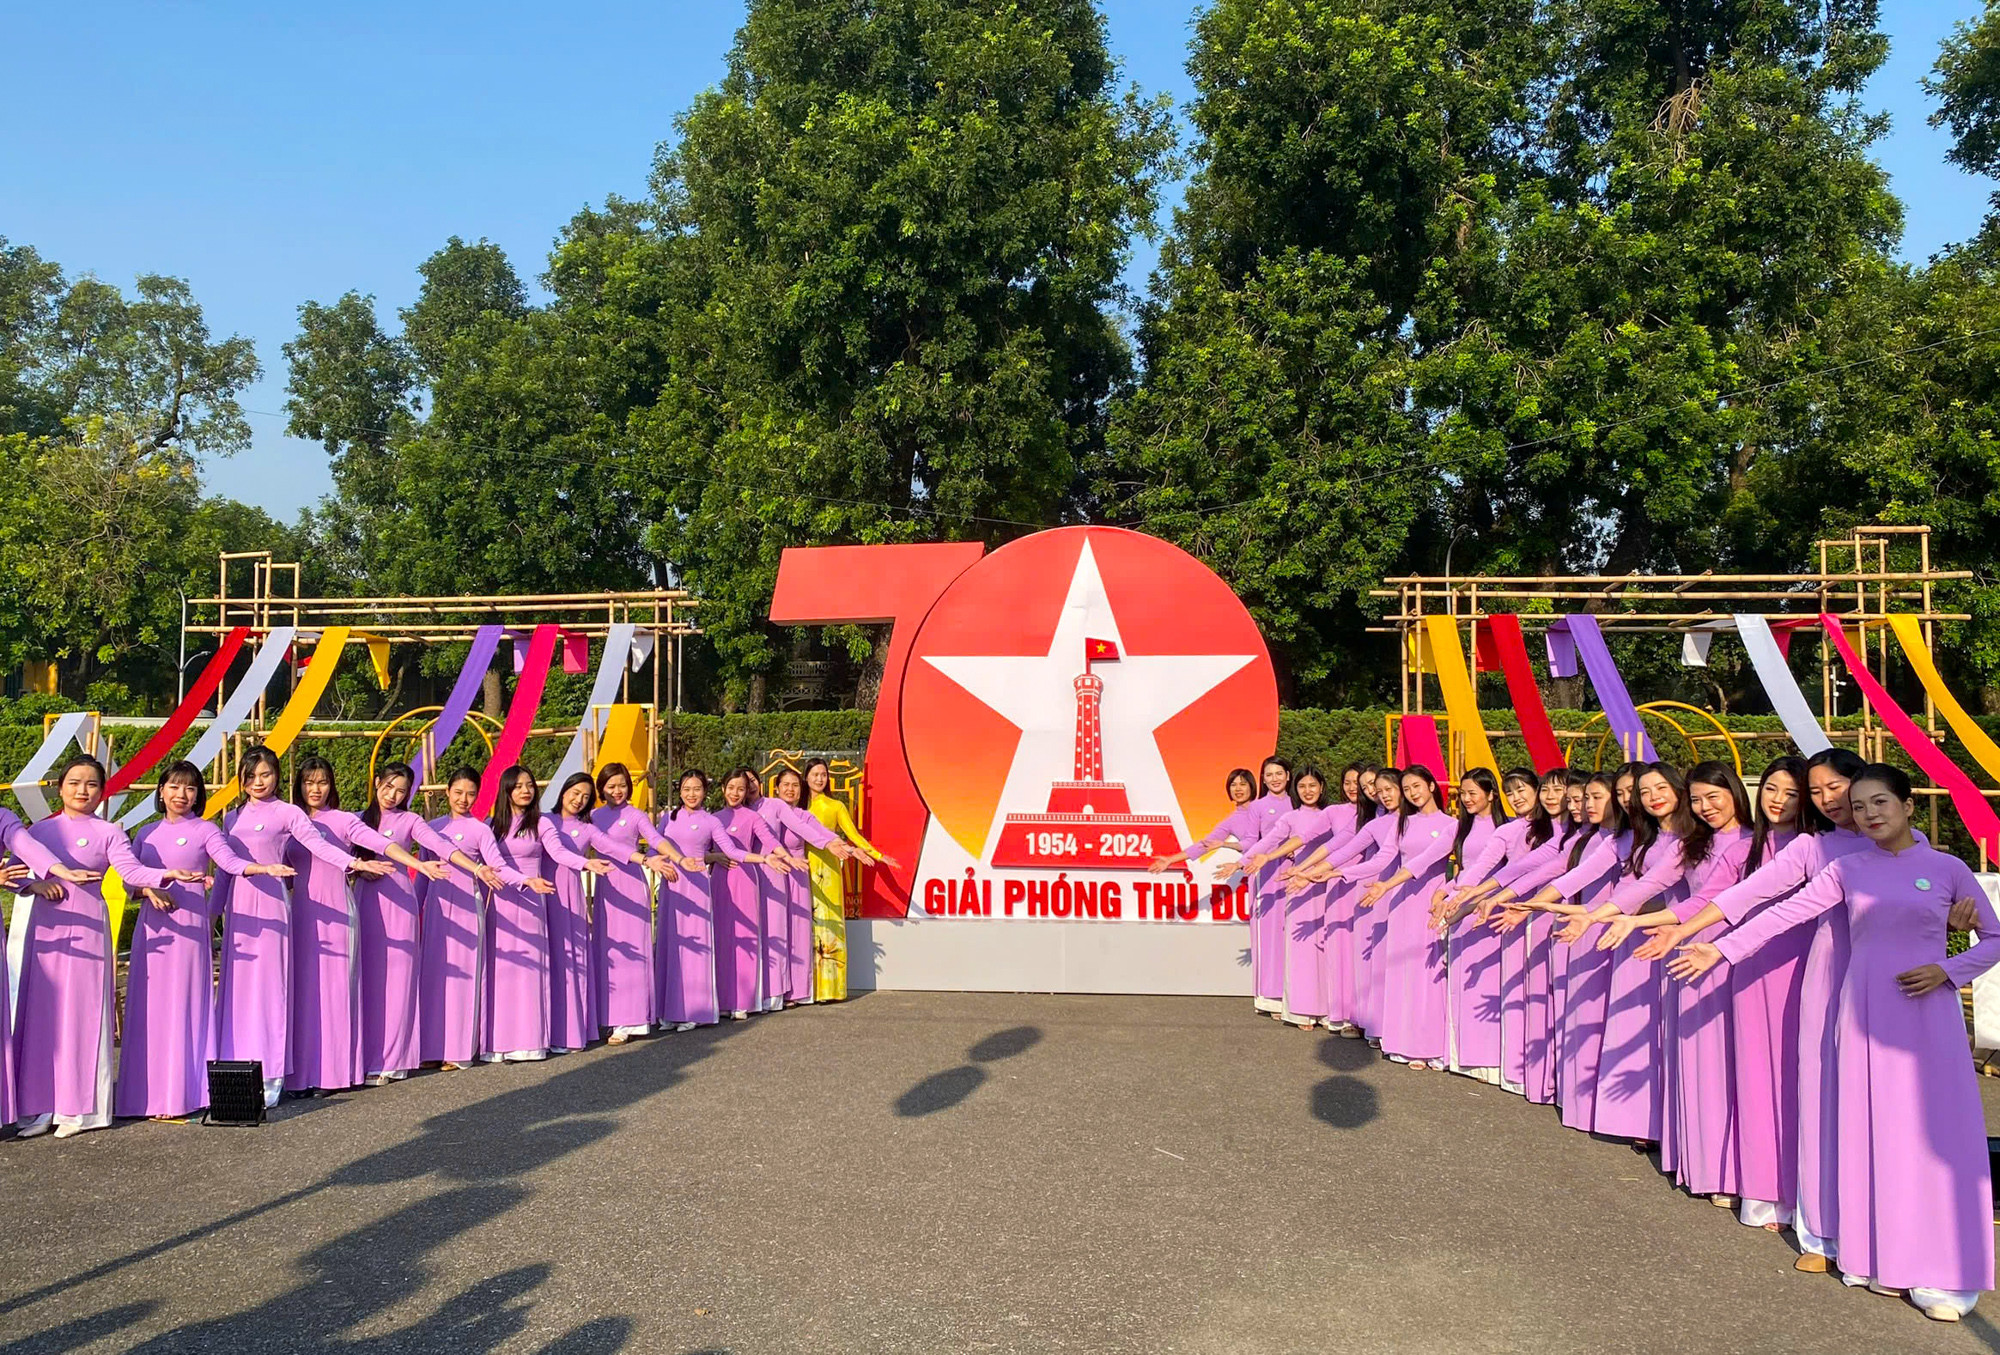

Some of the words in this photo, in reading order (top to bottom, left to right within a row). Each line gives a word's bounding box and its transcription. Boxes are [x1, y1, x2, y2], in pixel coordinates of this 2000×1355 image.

[1026, 832, 1078, 856] 1954
[1100, 834, 1153, 857] 2024
[924, 866, 992, 916] GIẢI
[1004, 872, 1122, 918] PHÓNG
[1133, 870, 1199, 920] THỦ
